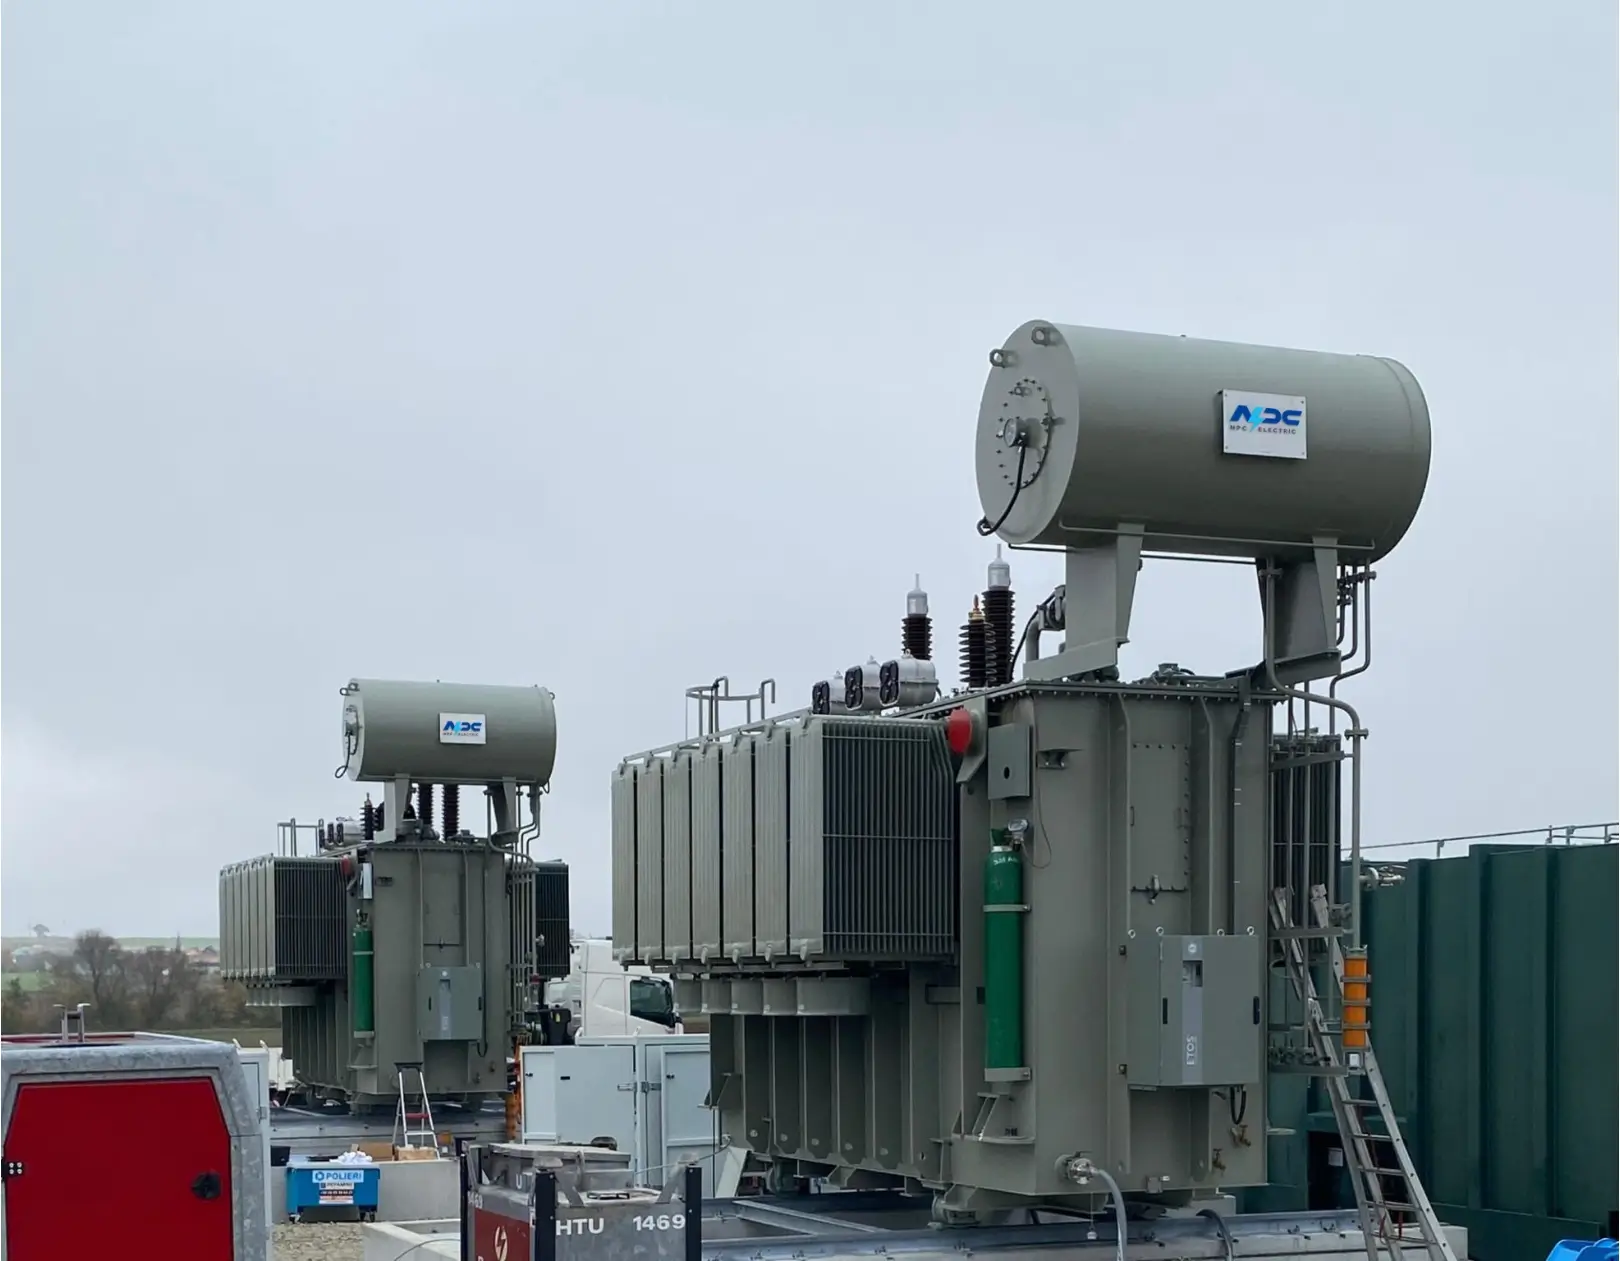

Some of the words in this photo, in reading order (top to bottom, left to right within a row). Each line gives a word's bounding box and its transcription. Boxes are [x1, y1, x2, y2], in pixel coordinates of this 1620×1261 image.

[1186, 1035, 1195, 1065] ETOS
[556, 1218, 605, 1235] HTU
[633, 1214, 686, 1231] 1469
